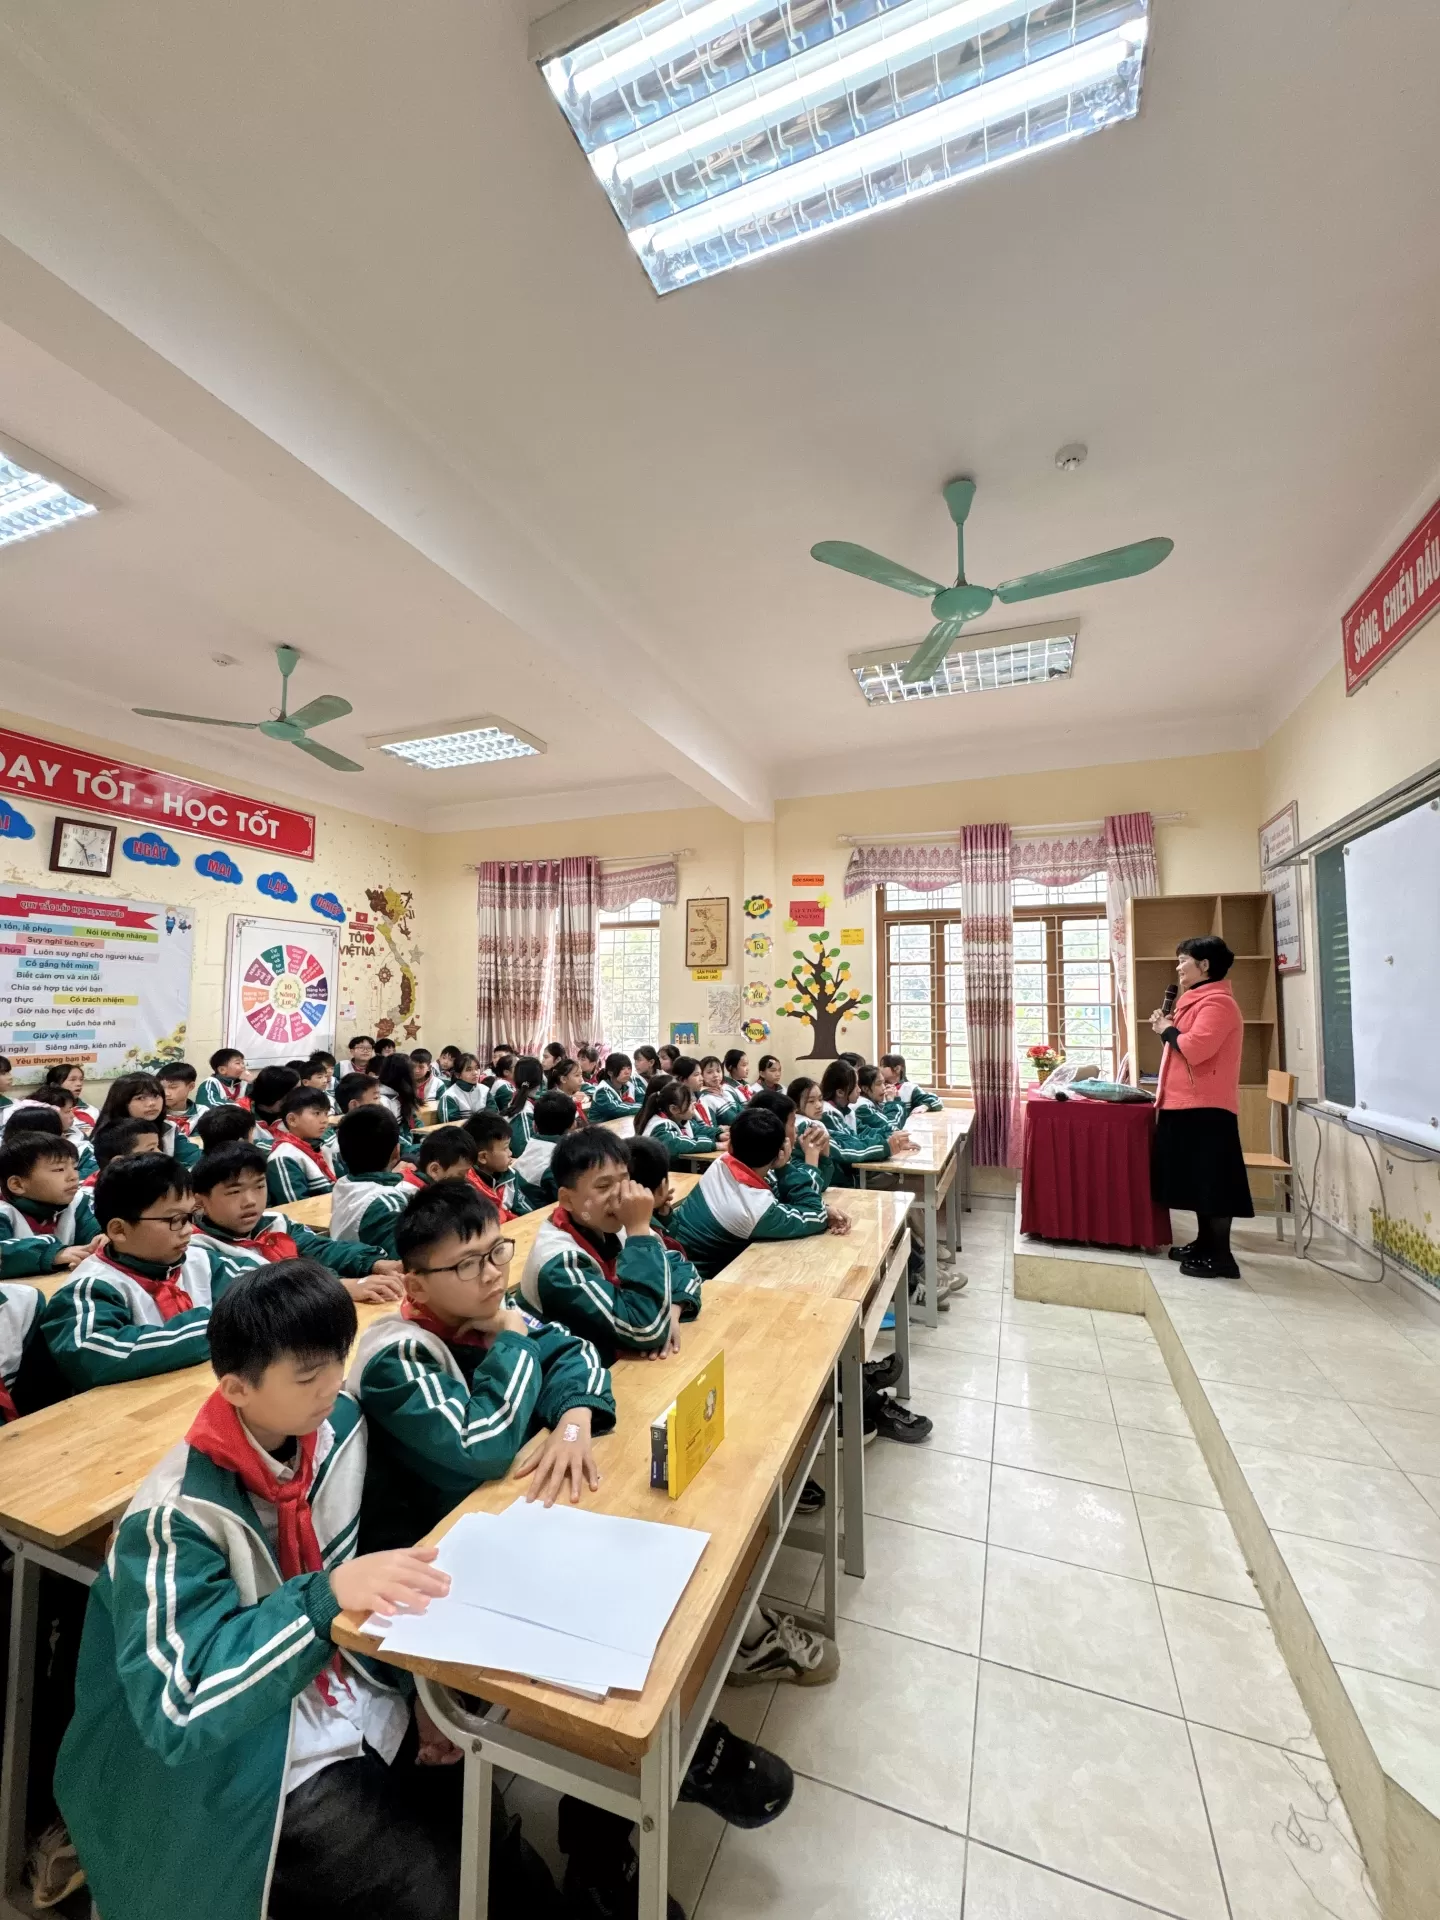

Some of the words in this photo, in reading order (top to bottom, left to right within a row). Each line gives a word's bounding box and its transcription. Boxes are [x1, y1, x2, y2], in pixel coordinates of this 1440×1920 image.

[1383, 561, 1415, 633] CHIẾN
[73, 768, 136, 806] TỐT
[163, 792, 228, 827] HỌC
[236, 809, 280, 839] TỐT
[133, 840, 168, 860] NGÀY
[207, 859, 231, 878] MAI
[268, 877, 289, 894] LẬP
